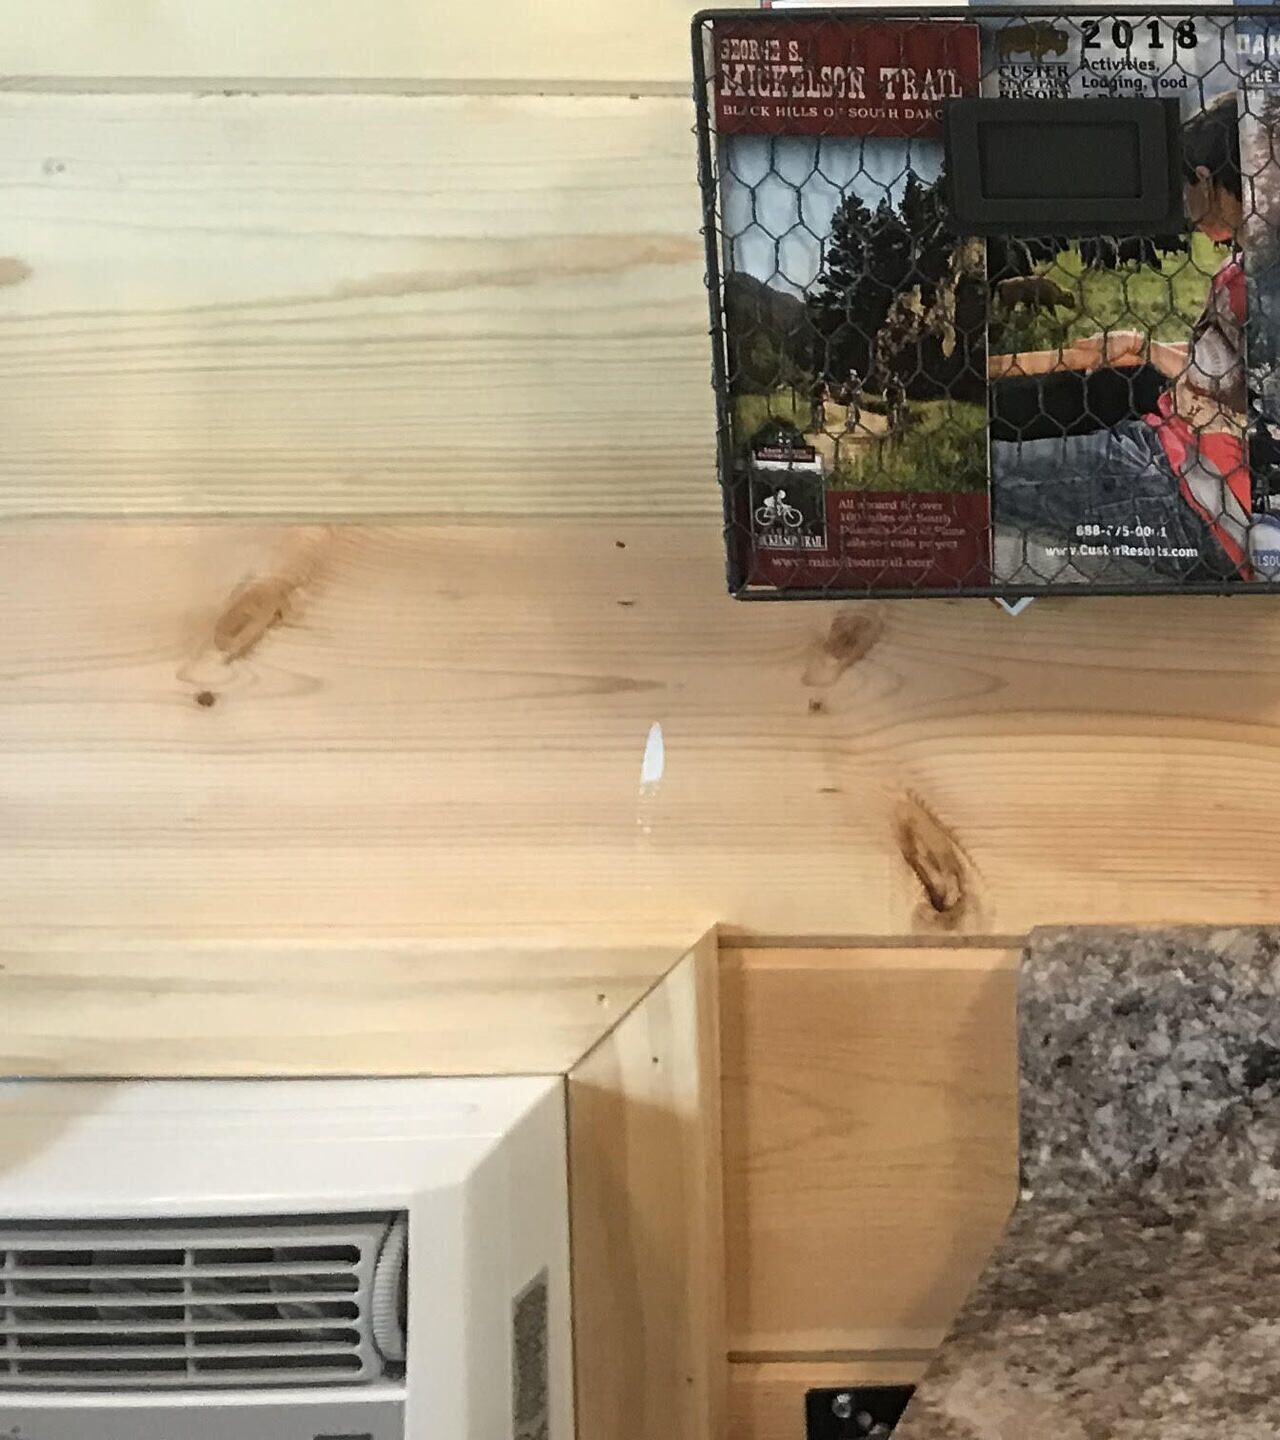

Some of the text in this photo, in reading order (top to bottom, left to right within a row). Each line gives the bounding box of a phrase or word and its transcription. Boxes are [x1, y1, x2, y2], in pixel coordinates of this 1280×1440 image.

[1081, 20, 1198, 49] 2018
[998, 65, 1068, 78] CUSTER
[880, 67, 963, 101] TRAIL
[776, 106, 817, 117] HILLS
